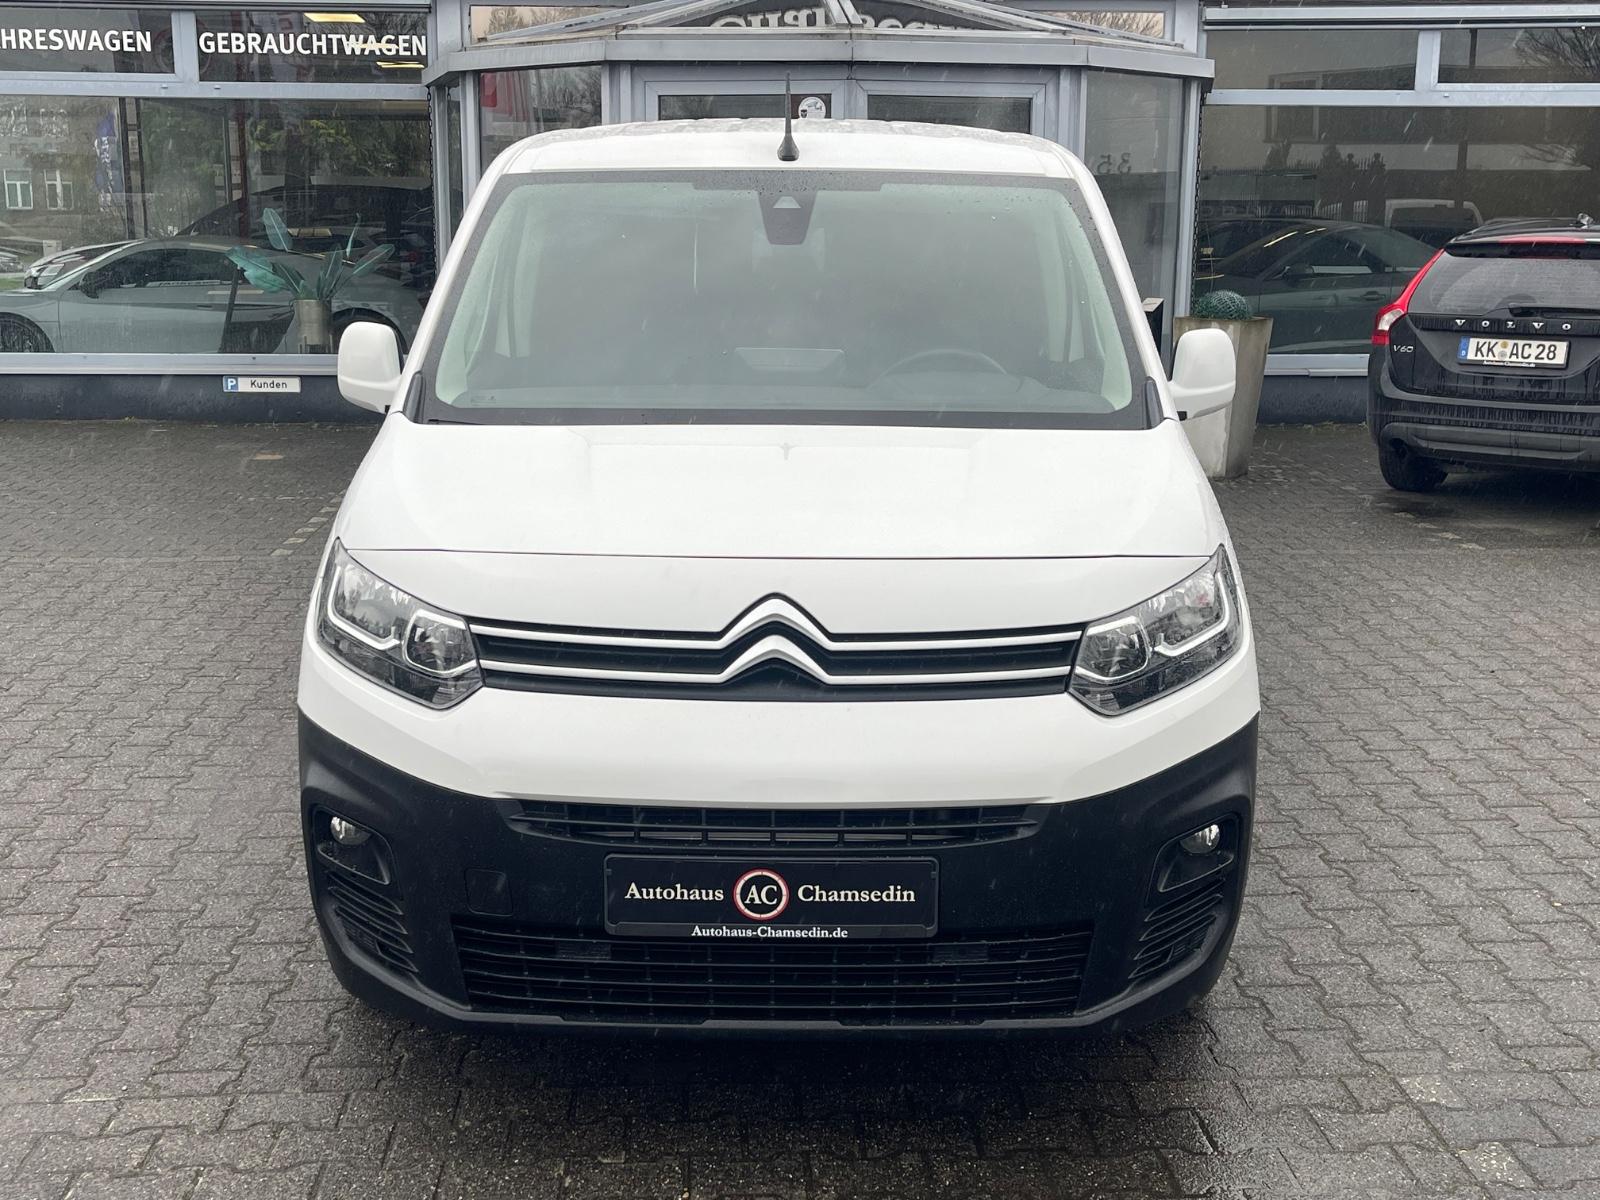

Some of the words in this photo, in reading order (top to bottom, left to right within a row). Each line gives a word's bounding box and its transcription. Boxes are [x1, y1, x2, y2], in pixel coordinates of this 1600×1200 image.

[0, 28, 152, 52] HRESWAGEN
[199, 32, 427, 56] GEBRAUCHTWAGEN
[1455, 319, 1571, 331] VOLVO
[1393, 344, 1414, 353] V60
[227, 378, 236, 390] P
[250, 379, 288, 389] Kunden
[624, 882, 724, 901] Autohaus
[745, 885, 778, 905] AC
[797, 884, 916, 902] Chamsedin
[691, 925, 848, 939] Autohaus-Chamsedin.de
